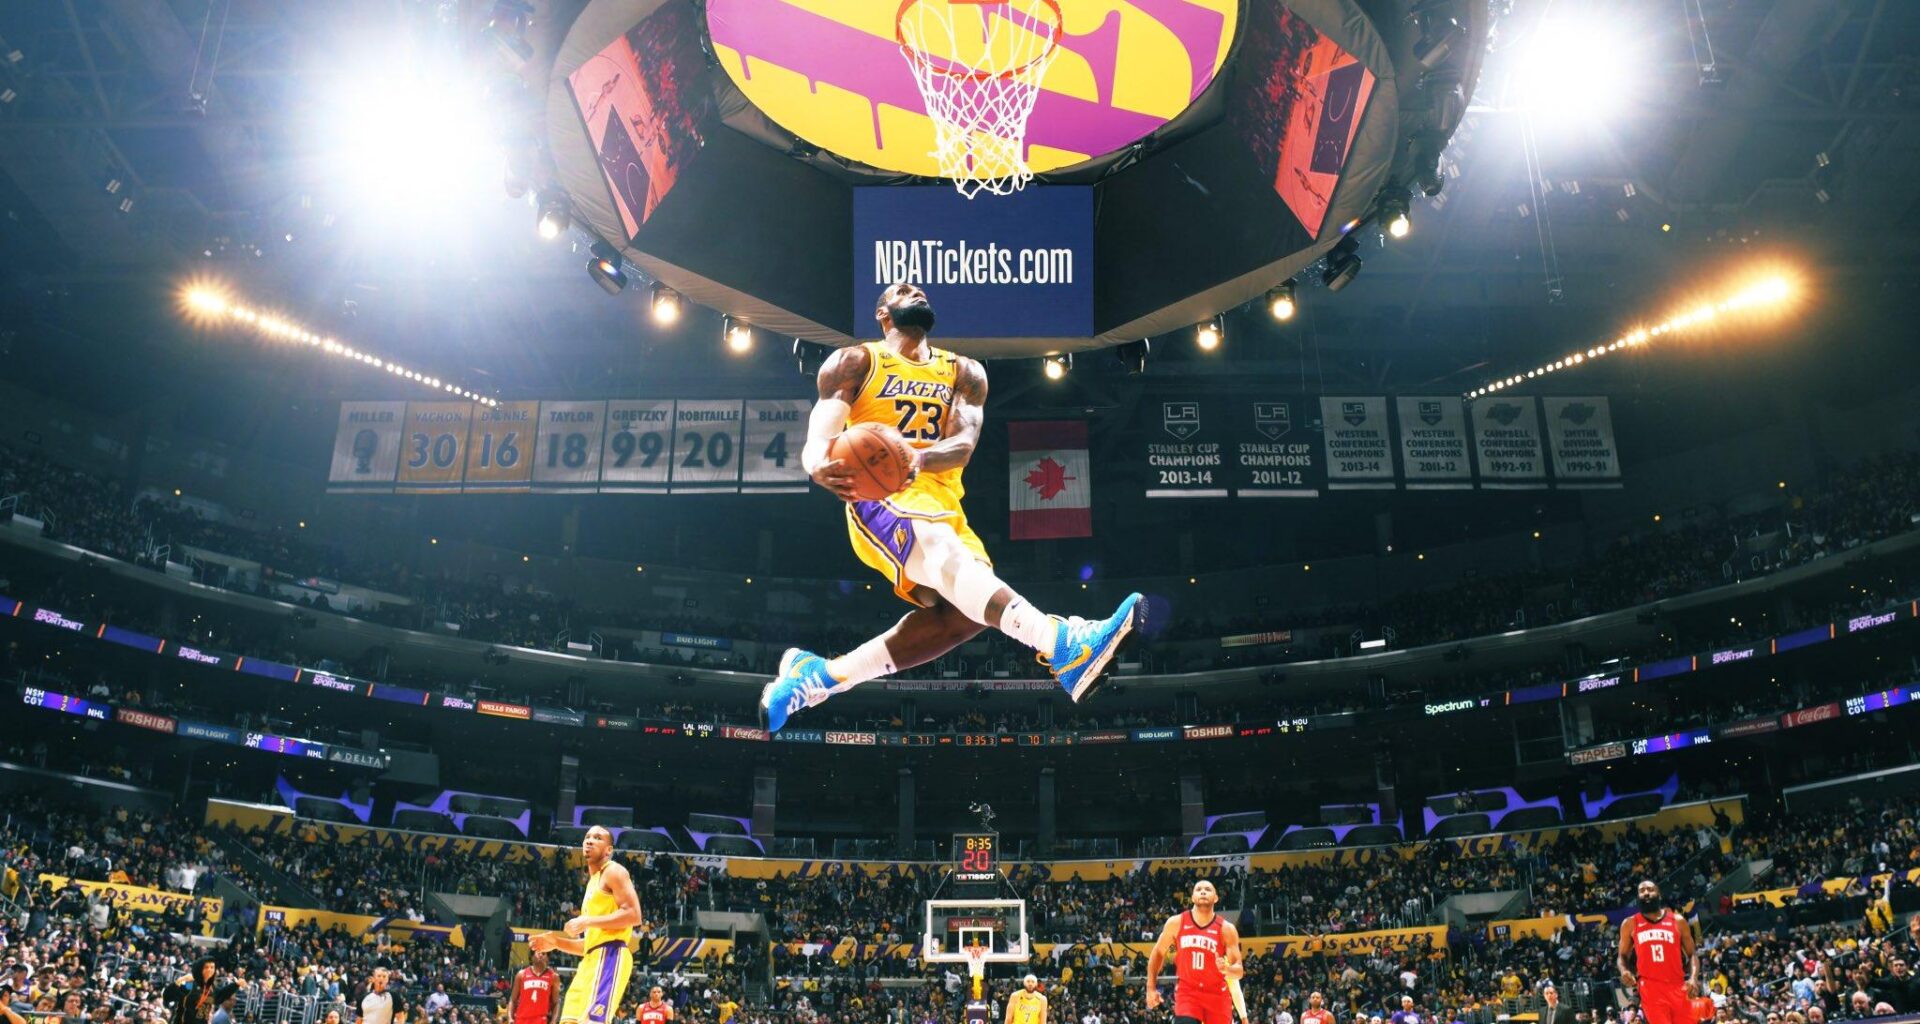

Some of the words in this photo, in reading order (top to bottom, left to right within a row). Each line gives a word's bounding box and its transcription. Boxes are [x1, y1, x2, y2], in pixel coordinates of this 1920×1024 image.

[875, 240, 1073, 284] NBATickets.com
[876, 374, 953, 405] LAKERS
[349, 411, 394, 423] MILLER
[416, 412, 462, 422] VACHON
[550, 411, 594, 422] TAYLOR
[612, 410, 667, 422] GRETZKY
[679, 411, 740, 421] ROBITAILLE
[759, 411, 799, 422] BLAKE
[1167, 406, 1197, 418] LA
[1258, 406, 1287, 418] LA
[895, 399, 943, 440] 23
[1334, 430, 1378, 438] WESTERN
[1412, 430, 1455, 438] WESTERN
[1484, 430, 1530, 438] CAMPBELL
[1148, 444, 1193, 454] STANLEY
[1197, 443, 1219, 453] CUP
[1239, 444, 1284, 454] STANLEY
[1289, 444, 1310, 453] CUP
[1329, 439, 1386, 448] CONFERENCE
[1406, 439, 1463, 448] CONFERENCE
[1480, 439, 1537, 448] CONFERENCE
[408, 432, 458, 469] 30
[480, 432, 520, 469] 16
[547, 432, 587, 468] 18
[612, 431, 664, 468] 99
[680, 431, 733, 468] 20
[763, 432, 788, 468] 4
[1333, 450, 1385, 458] CHAMPIONS
[1410, 450, 1462, 458] CHAMPIONS
[1484, 450, 1536, 458] CHAMPIONS
[1559, 450, 1610, 458] CHAMPIONS
[1149, 455, 1221, 466] CHAMPIONS
[1240, 455, 1311, 466] CHAMPIONS
[1341, 462, 1380, 472] 2013-14
[1419, 462, 1456, 472] 2011-12
[1491, 462, 1532, 472] 1992-93
[1159, 470, 1213, 484] 2013-14
[1252, 470, 1302, 484] 2011-12
[34, 612, 84, 631] SPORTSNET
[1849, 612, 1896, 632] SPORTSNET
[178, 650, 220, 665] SPORTSNET
[1712, 649, 1754, 664] SPORTSNET
[313, 677, 356, 692] SPORTSNET
[1579, 677, 1620, 692] SPORTSNET
[25, 687, 45, 698] NSH
[1846, 696, 1864, 707] NSH
[87, 708, 104, 719] NHL
[481, 703, 504, 713] WELLS
[505, 706, 528, 716] FARGO
[1425, 700, 1473, 716] Spectrum
[119, 709, 174, 733] TOSHIBA
[1292, 718, 1308, 726] HOU
[683, 723, 695, 731] LAL
[698, 723, 714, 732] HOU
[1185, 726, 1233, 738] TOSHIBA
[187, 727, 205, 736] BUD
[206, 729, 230, 740] LIGHT
[700, 730, 708, 738] 21
[786, 732, 822, 741] DELTA
[826, 733, 875, 744] STAPLES
[965, 736, 986, 745] 8:35
[1028, 736, 1040, 745] 70
[1632, 739, 1648, 748] CAR
[1694, 735, 1711, 744] NHL
[307, 749, 323, 759] NHL
[345, 753, 381, 766] DELTA
[1572, 745, 1625, 763] STAPLES
[967, 838, 992, 849] 8:35
[963, 850, 988, 871] 20
[1637, 928, 1674, 945] ROCKETS
[1180, 934, 1217, 953] ROCKETS
[1650, 944, 1664, 962] 13
[1192, 952, 1205, 970] 10
[531, 990, 537, 1003] 4
